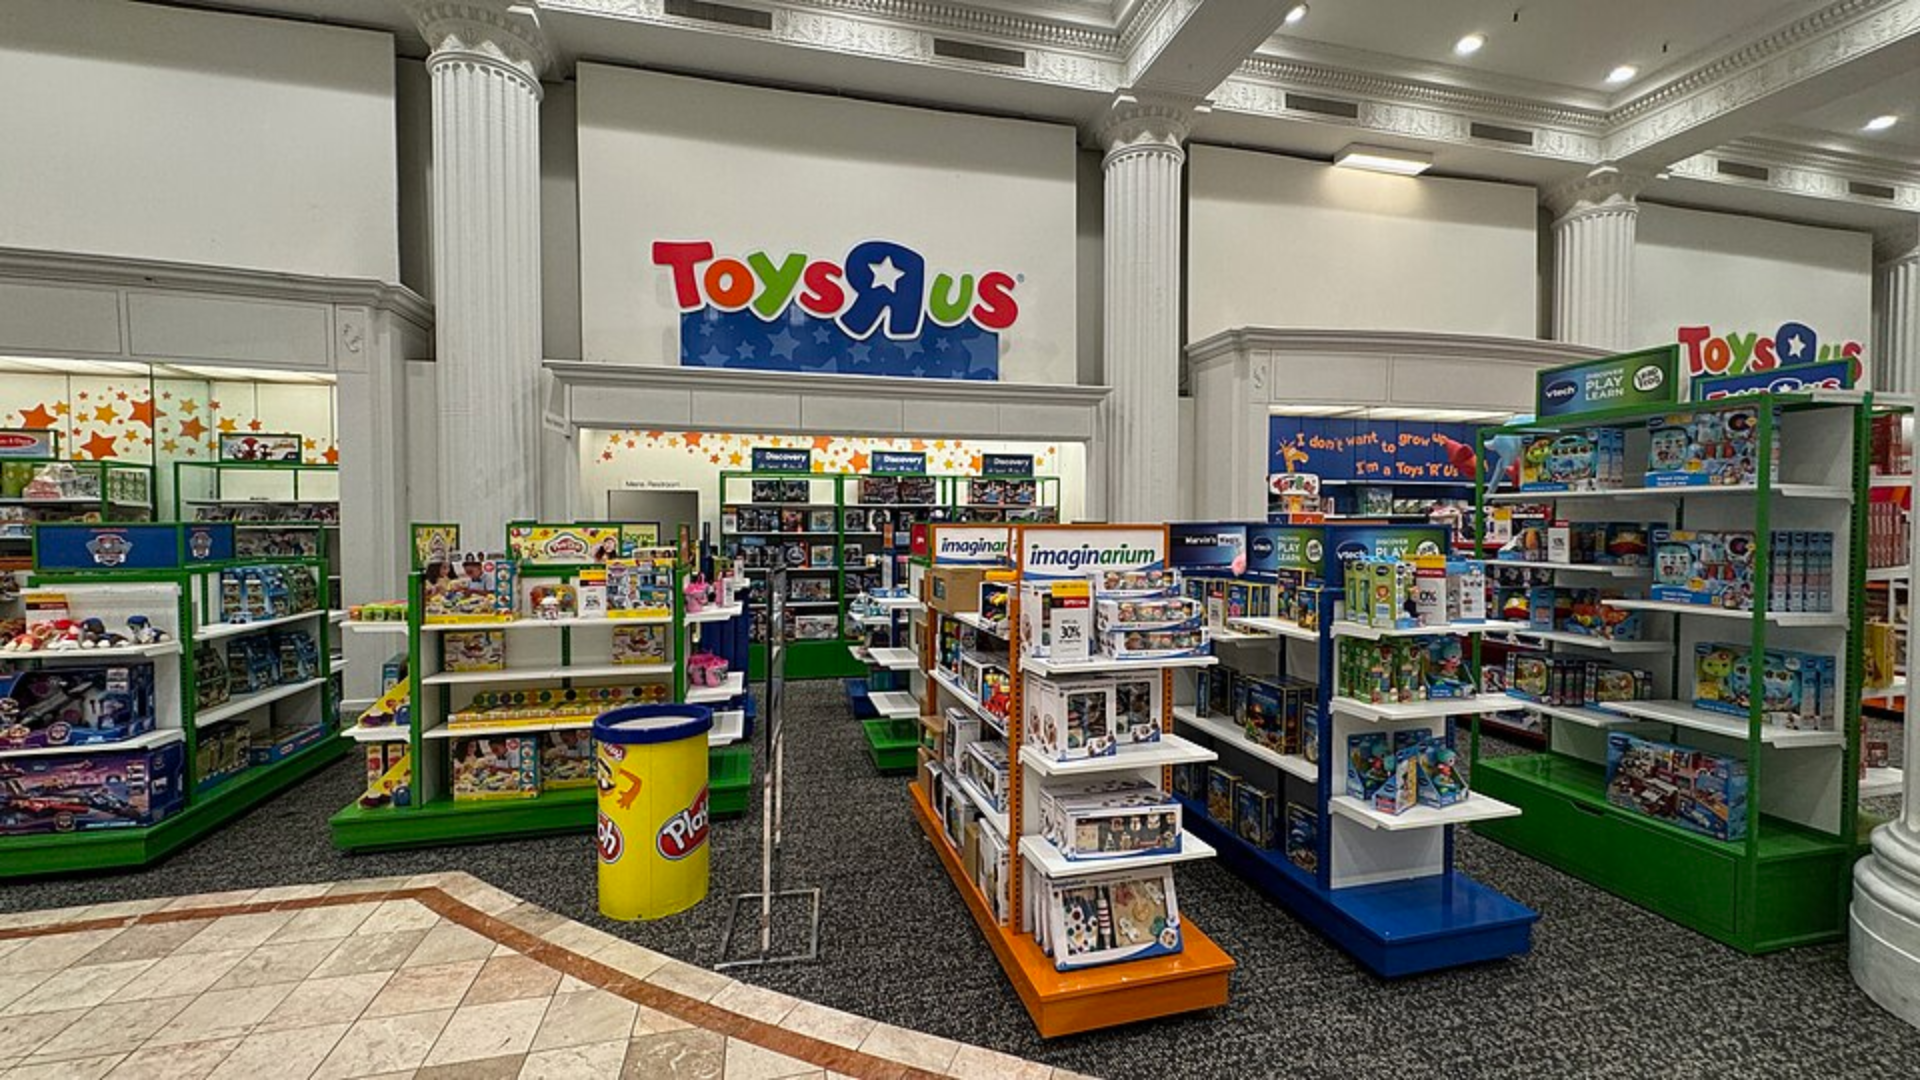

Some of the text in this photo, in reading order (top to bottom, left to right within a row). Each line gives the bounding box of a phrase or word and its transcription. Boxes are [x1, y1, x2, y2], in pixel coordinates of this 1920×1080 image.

[1585, 376, 1623, 391] PLAY
[1585, 388, 1625, 401] LEARN
[1296, 433, 1305, 447] I
[1345, 432, 1378, 446] want
[1381, 439, 1396, 454] to
[1399, 433, 1430, 447] grow
[765, 451, 806, 463] Discovery
[883, 455, 923, 465] Discovery
[993, 457, 1030, 466] Discovery
[1383, 465, 1391, 476] a
[1396, 462, 1424, 478] Toys
[942, 537, 1007, 556] imaginar
[1278, 542, 1300, 553] PLAY
[1030, 544, 1156, 569] imaginarium
